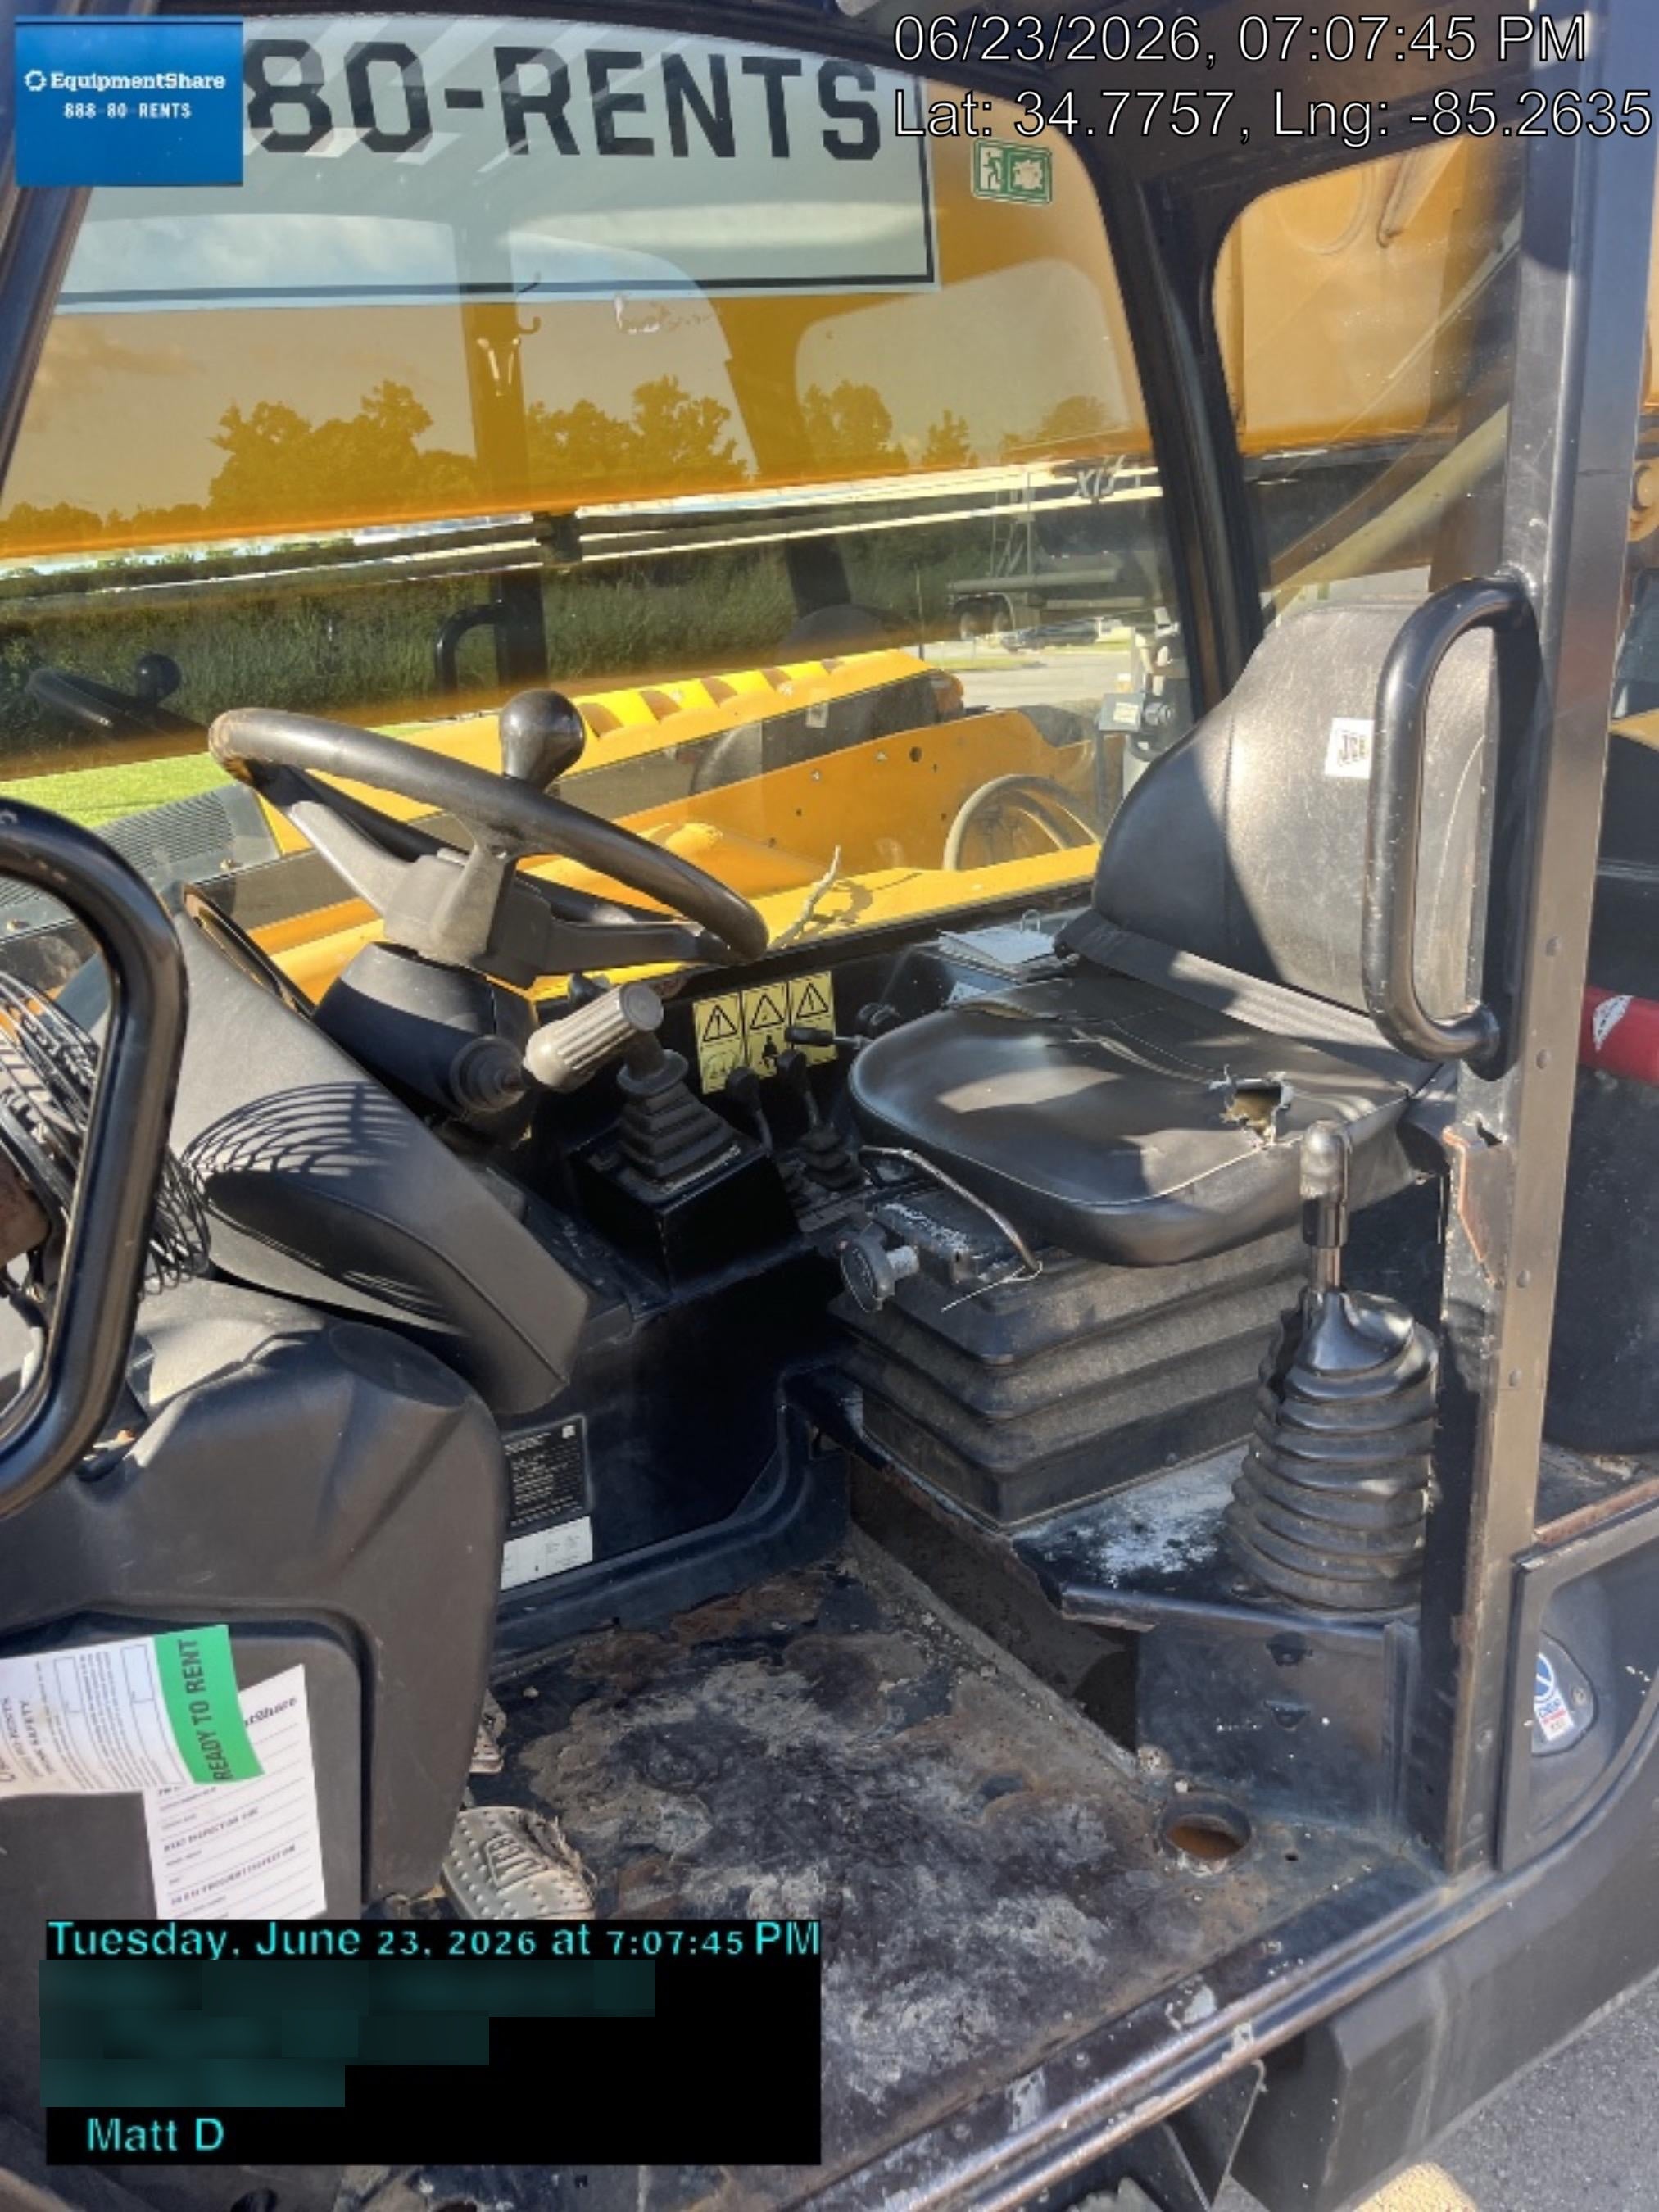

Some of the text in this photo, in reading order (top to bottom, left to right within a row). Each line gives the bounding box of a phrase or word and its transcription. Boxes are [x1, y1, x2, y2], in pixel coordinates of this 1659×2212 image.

[178, 1638, 234, 1781] READY TO RENT
